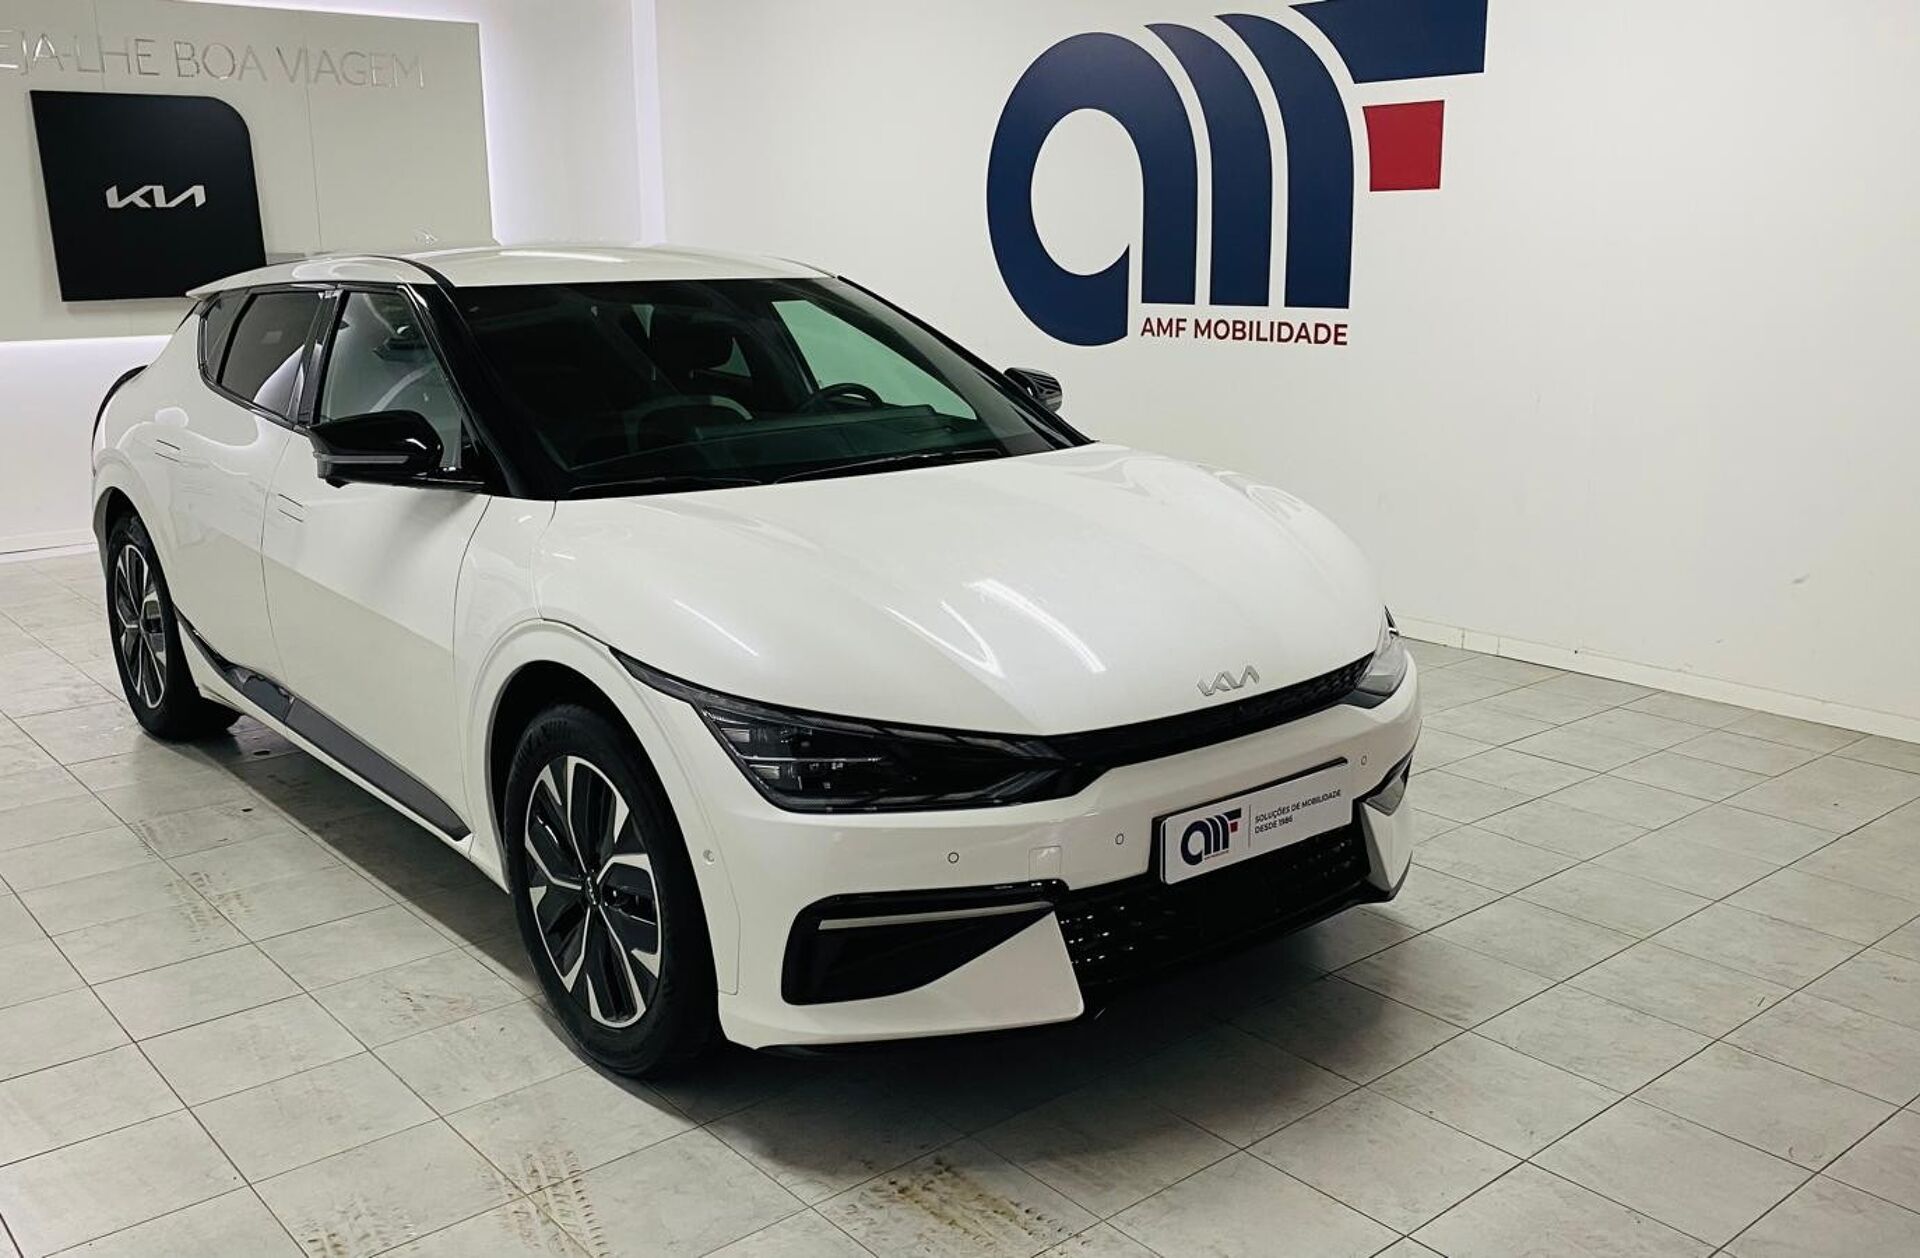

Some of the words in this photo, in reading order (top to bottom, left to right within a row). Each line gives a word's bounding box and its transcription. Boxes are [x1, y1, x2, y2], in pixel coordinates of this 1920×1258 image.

[174, 40, 267, 81] BOA
[275, 45, 425, 89] VIAGEM
[1141, 317, 1187, 338] AMF
[1194, 318, 1348, 345] MOBILIDADE
[1291, 802, 1301, 812] DE
[1255, 820, 1278, 834] DESDE
